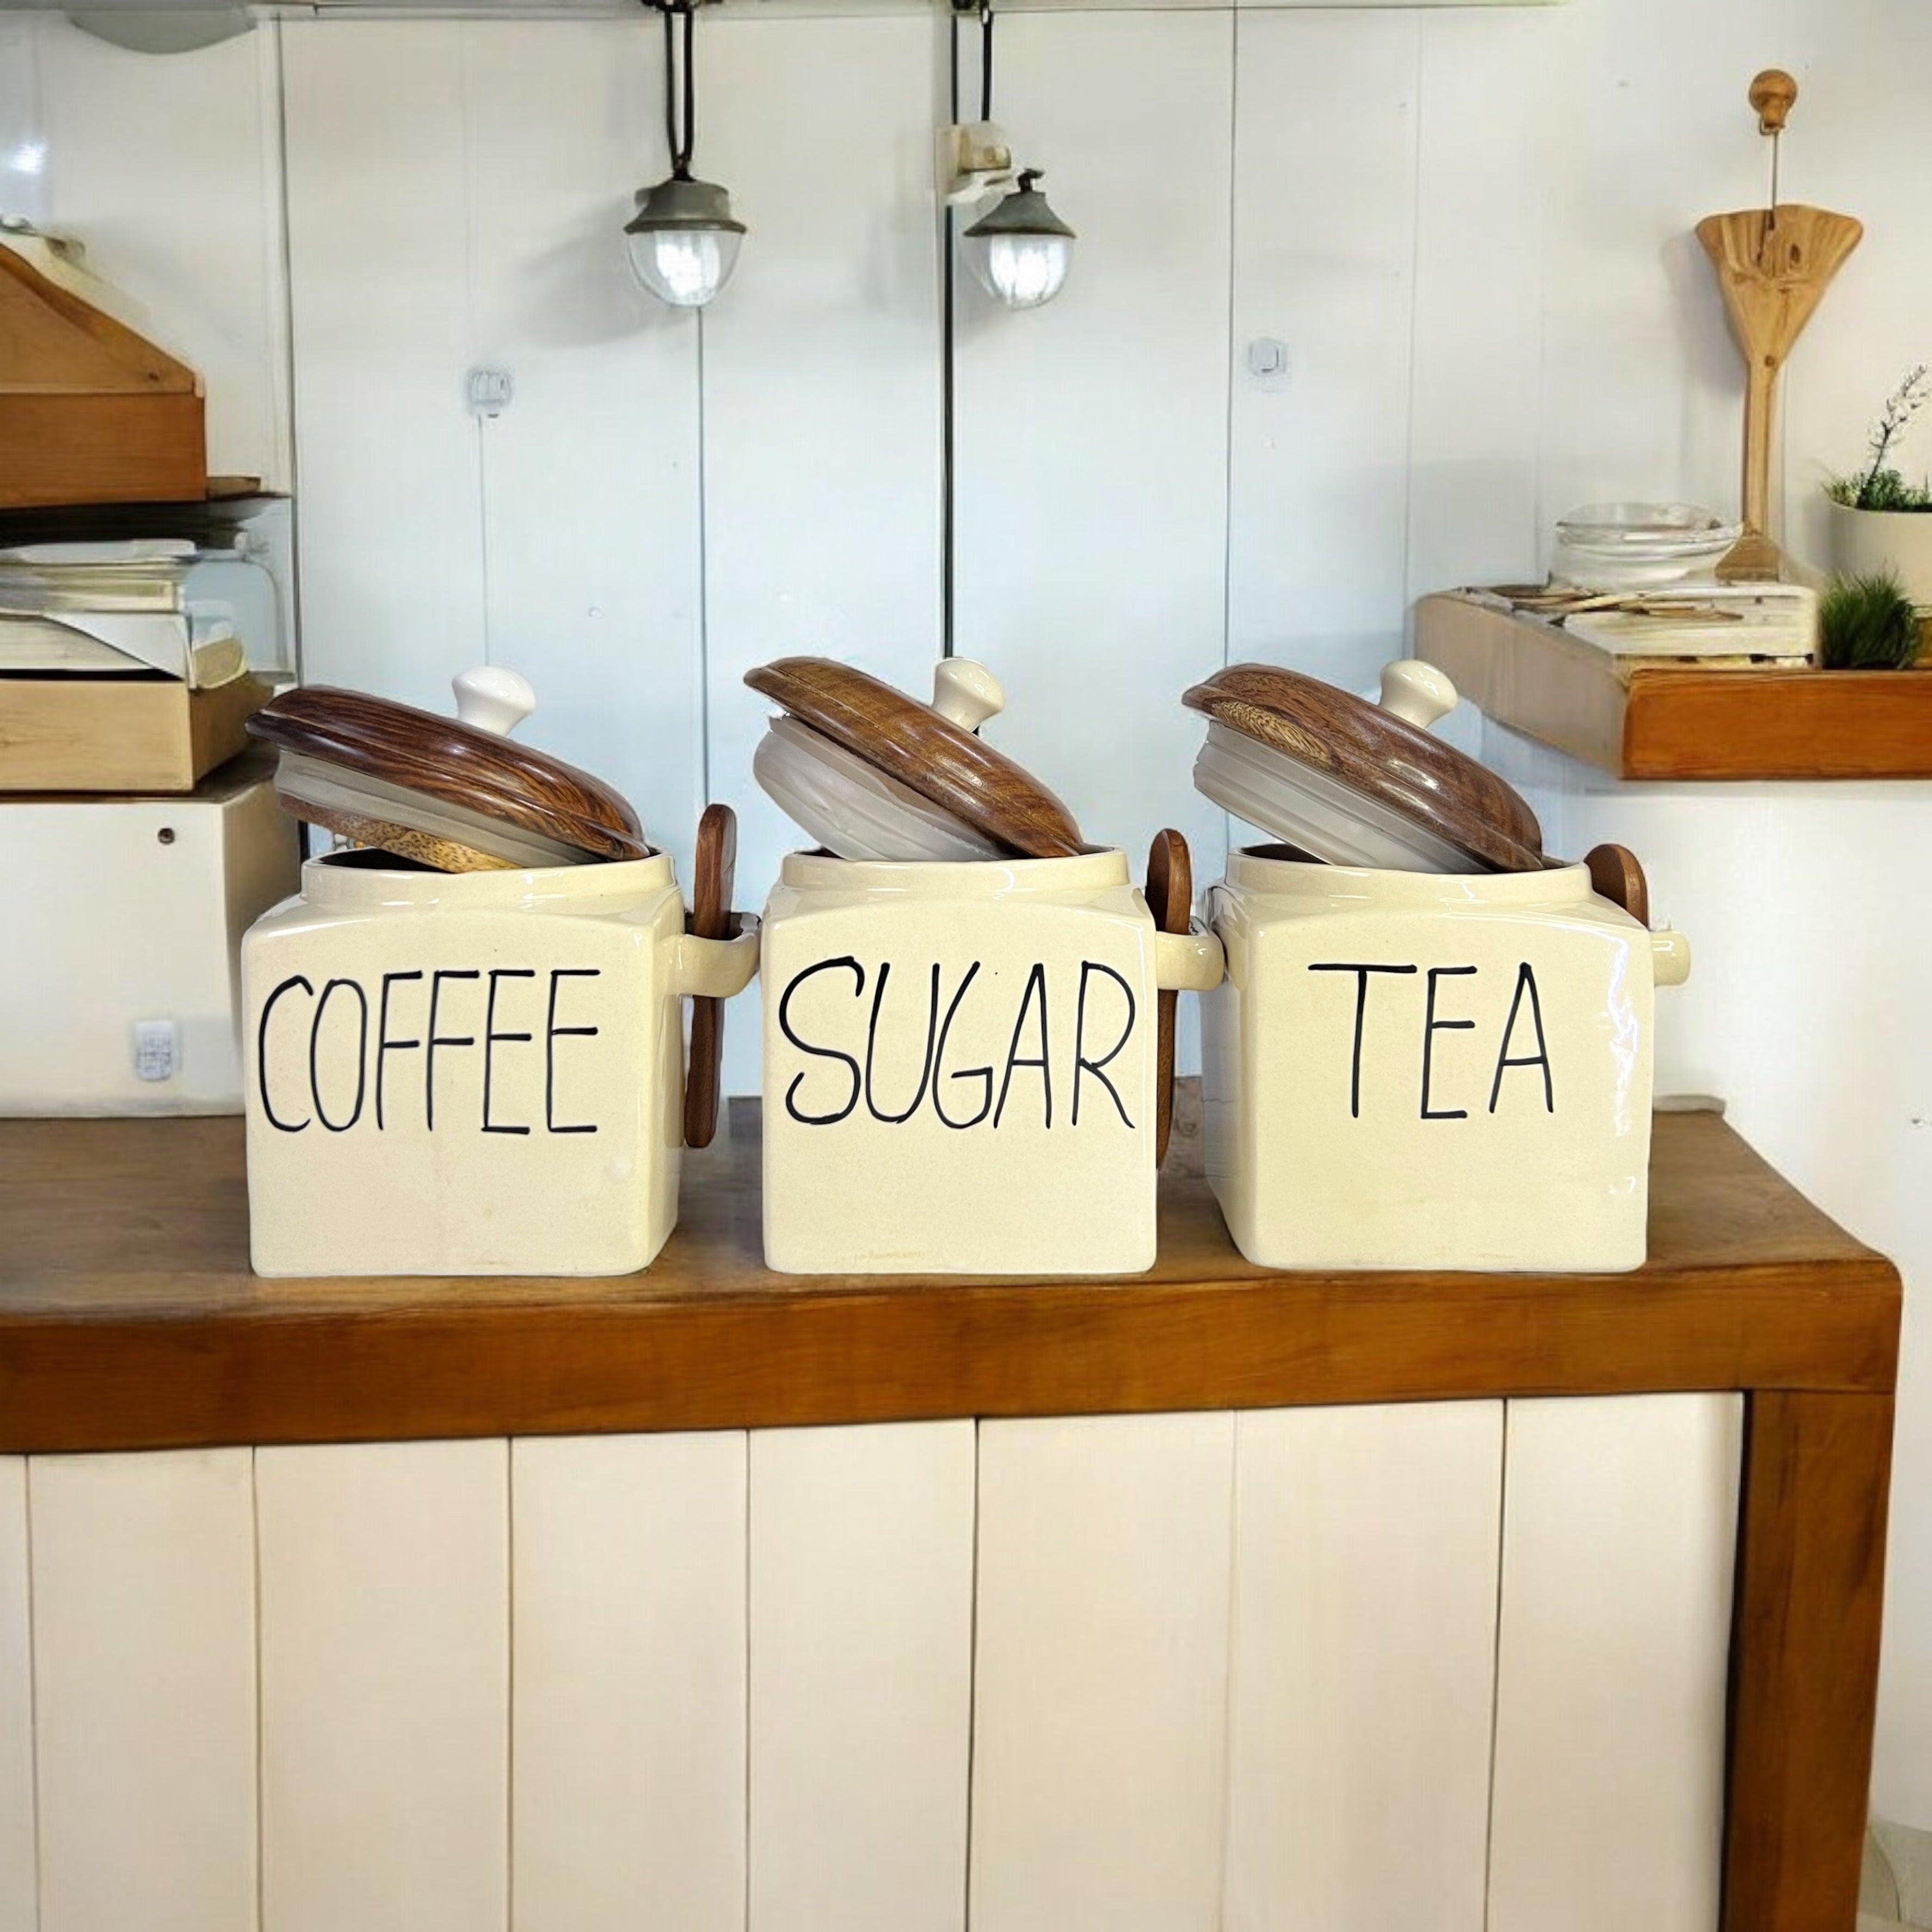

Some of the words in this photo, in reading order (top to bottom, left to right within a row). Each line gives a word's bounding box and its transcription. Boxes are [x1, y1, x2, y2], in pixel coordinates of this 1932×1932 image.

[259, 969, 600, 1135] COFFEE
[779, 956, 1135, 1129] SUGAR
[1308, 962, 1555, 1119] TEA
